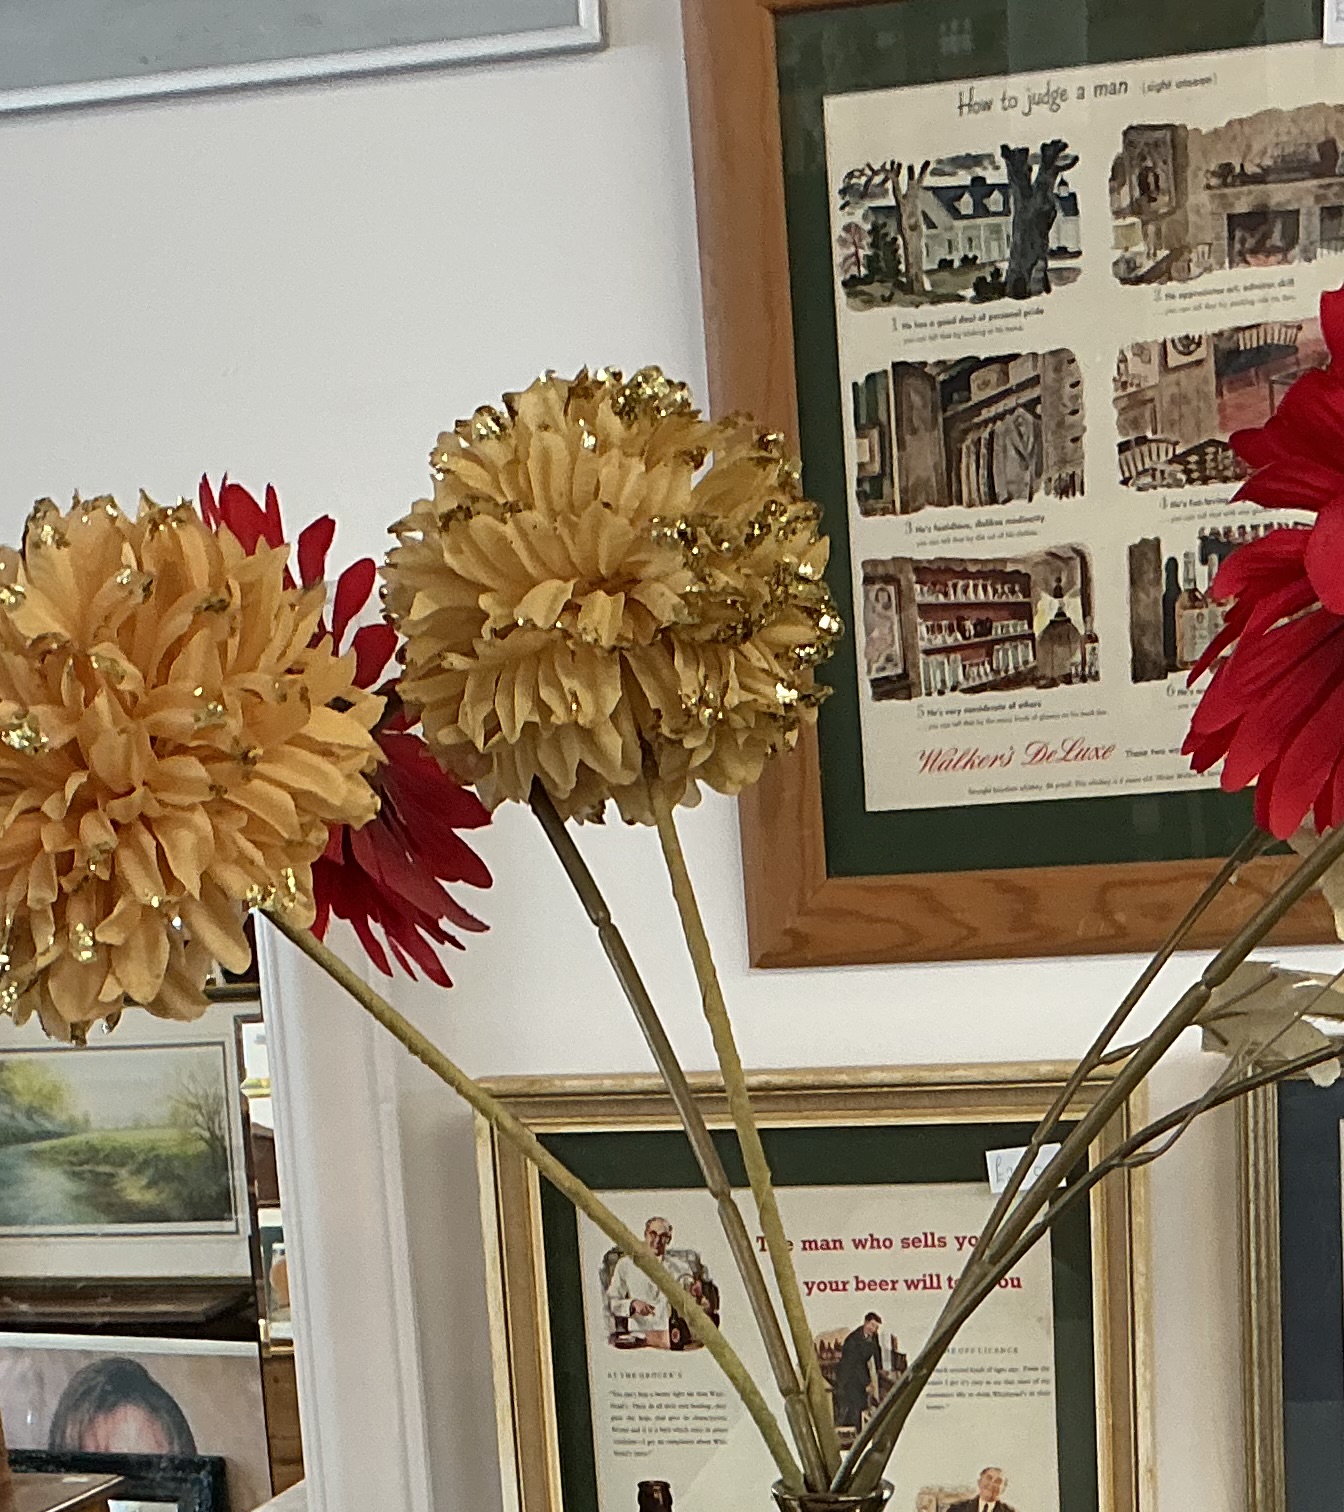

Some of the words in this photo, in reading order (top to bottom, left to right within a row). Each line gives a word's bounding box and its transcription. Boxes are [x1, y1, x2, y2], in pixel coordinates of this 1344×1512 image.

[957, 86, 992, 116] How
[1000, 91, 1018, 111] to
[1022, 80, 1068, 116] judge
[1076, 85, 1086, 100] a
[1093, 80, 1128, 97] man
[917, 745, 1016, 776] Walker's
[756, 1236, 794, 1252] Te
[801, 1239, 844, 1251] man
[852, 1234, 894, 1249] who
[901, 1232, 947, 1248] sells
[803, 1279, 848, 1296] your
[854, 1276, 899, 1292] beer
[903, 1274, 942, 1291] will
